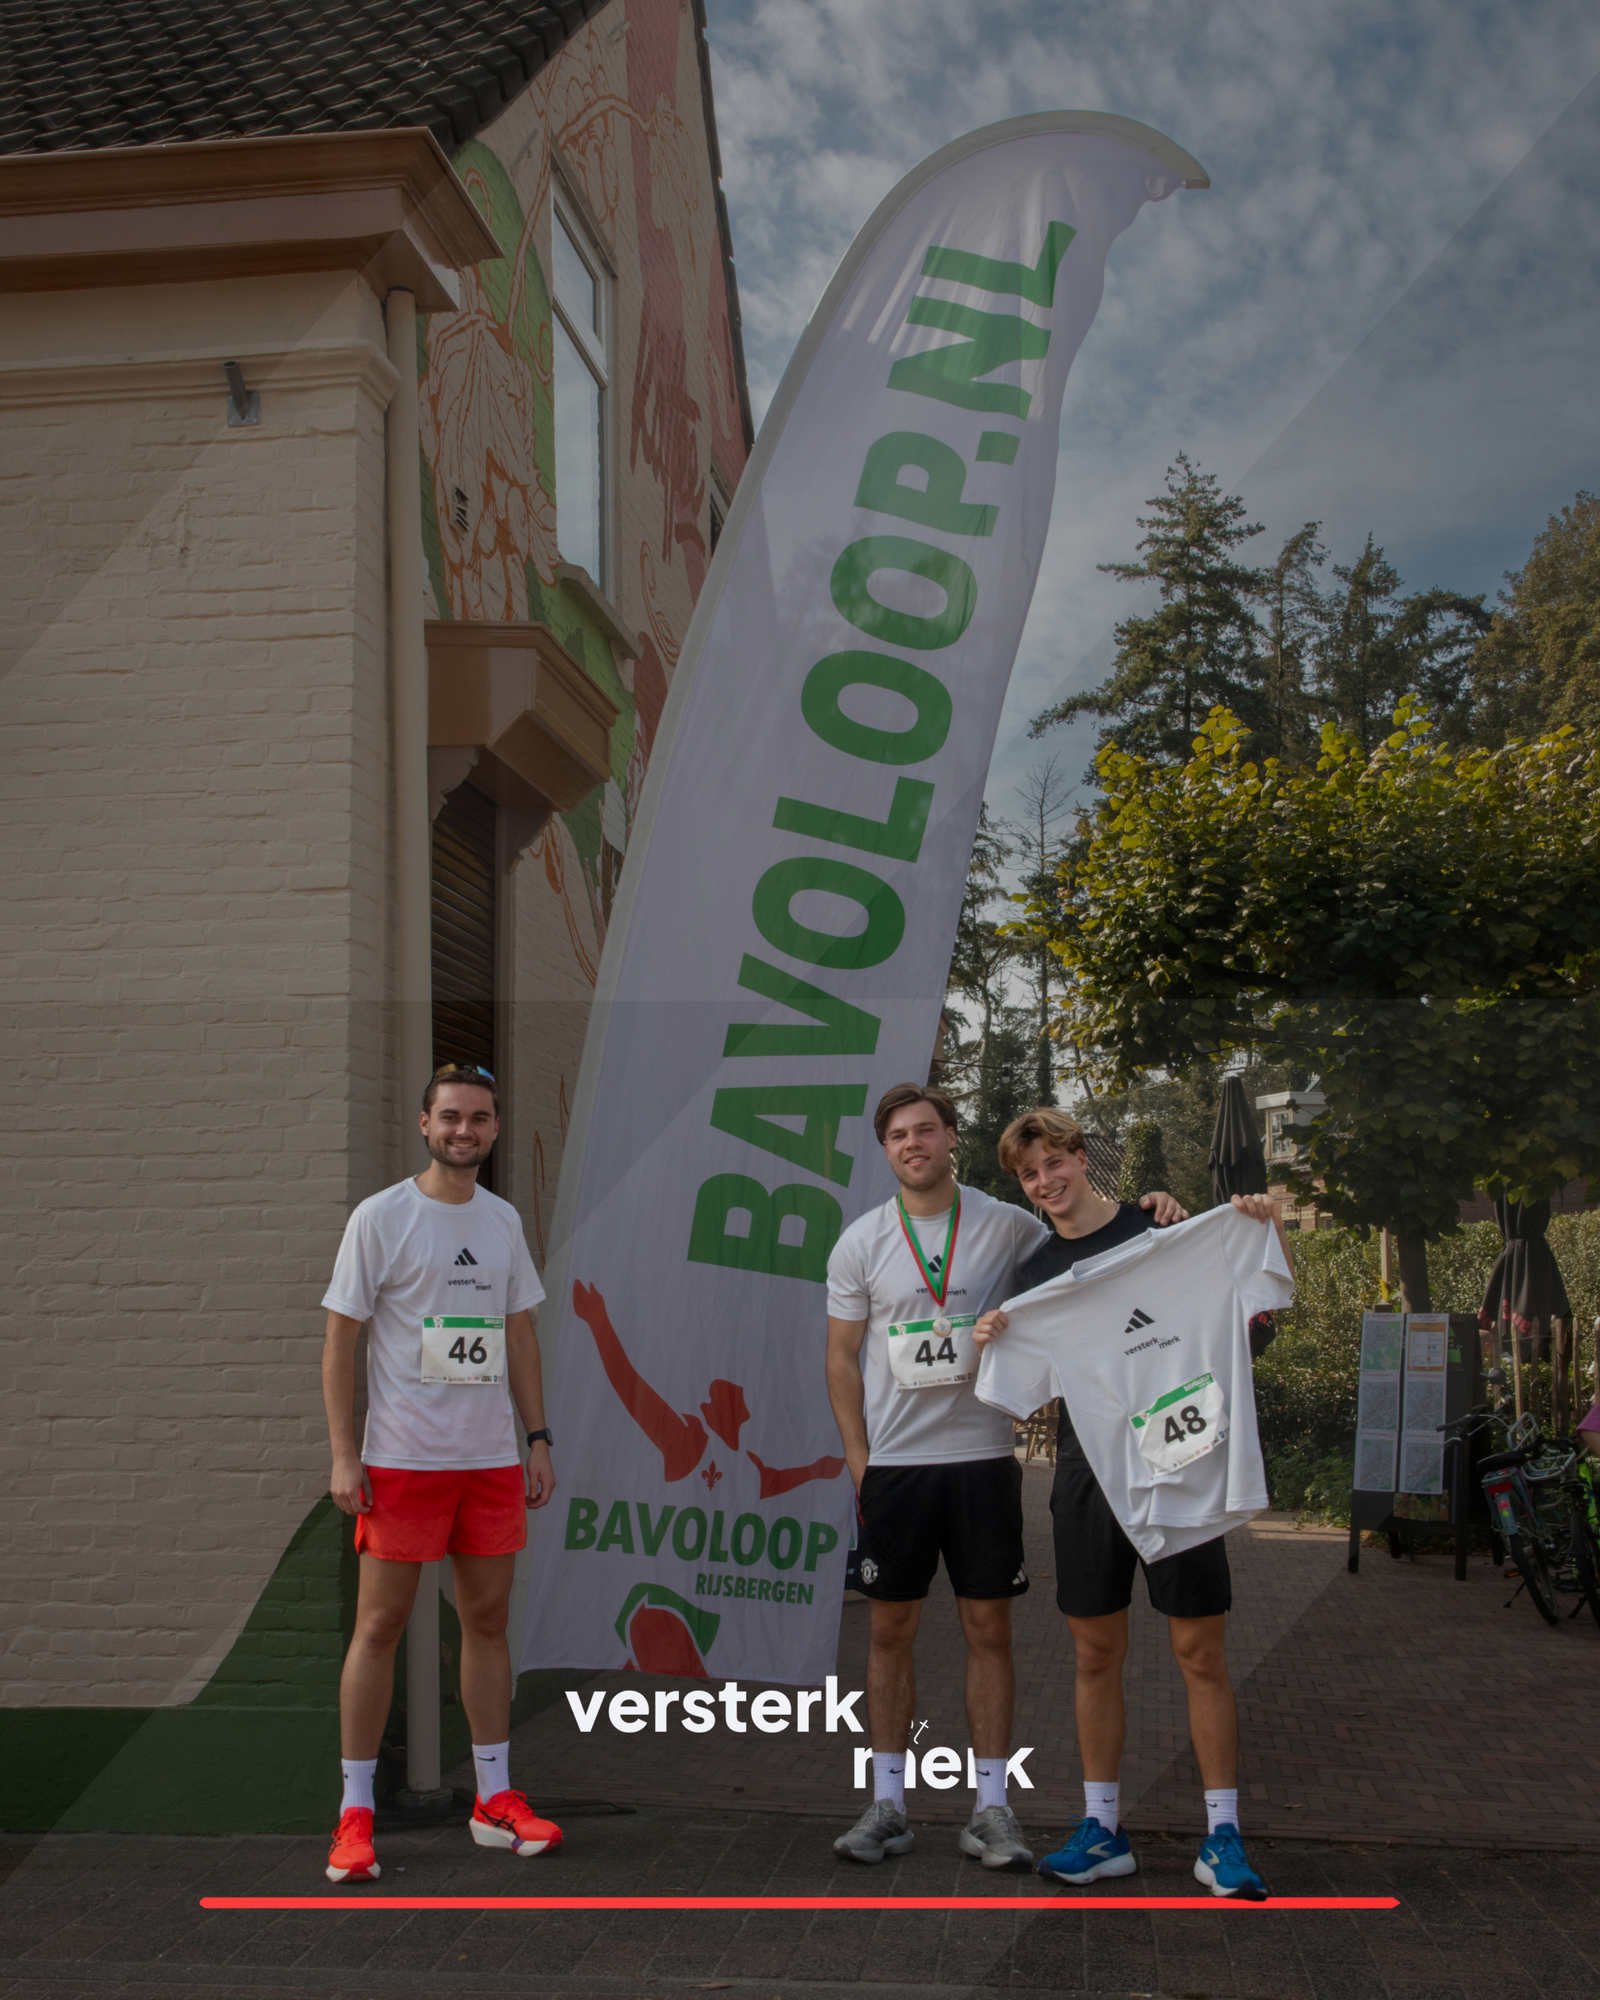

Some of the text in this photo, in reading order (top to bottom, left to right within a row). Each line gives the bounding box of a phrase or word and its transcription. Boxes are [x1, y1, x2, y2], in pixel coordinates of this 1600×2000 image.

[687, 220, 1078, 1285] BAVOLOOP.NL
[448, 1336, 487, 1364] 46
[915, 1337, 958, 1367] 44
[1124, 1337, 1159, 1356] versterk
[1158, 1335, 1181, 1349] merk
[1164, 1405, 1207, 1443] 48
[564, 1498, 838, 1572] BAVOLOOP
[695, 1573, 814, 1605] RIJSBERGEN
